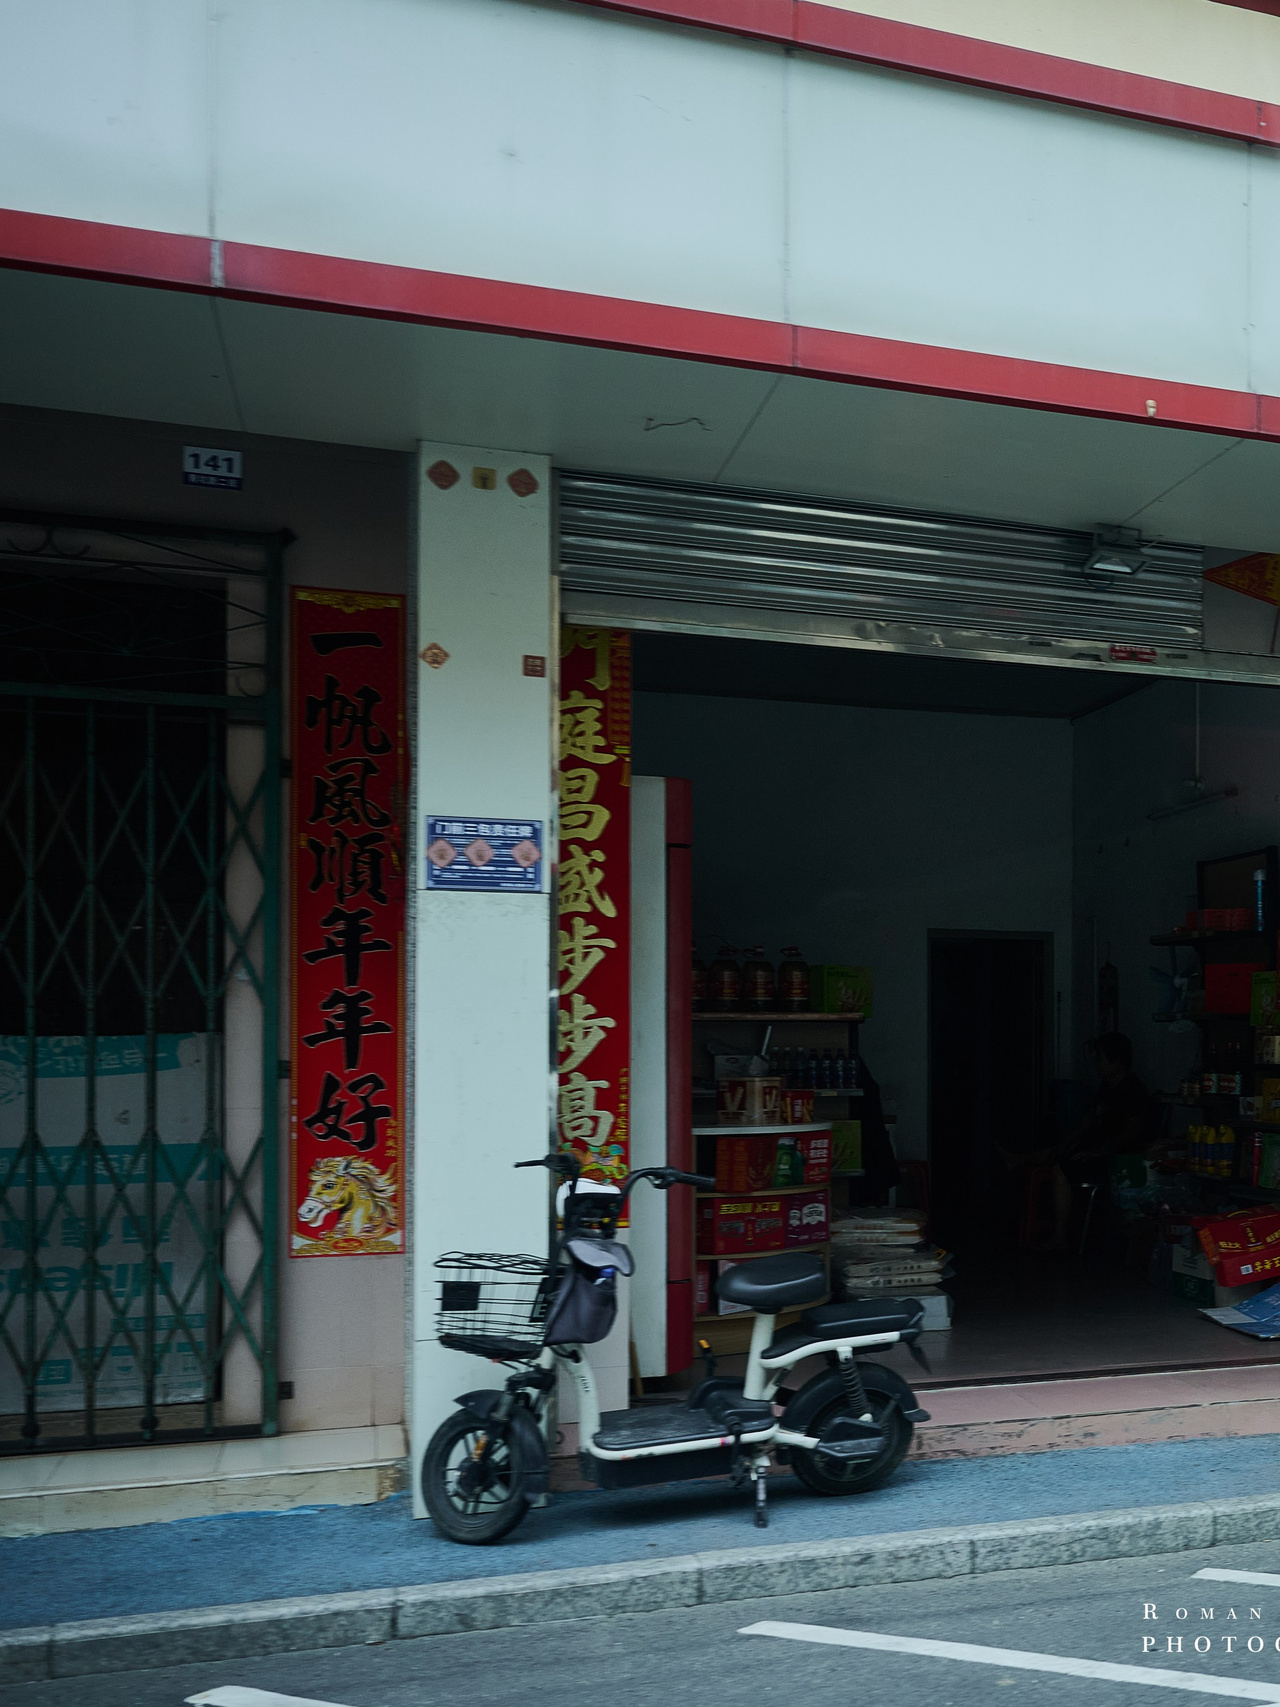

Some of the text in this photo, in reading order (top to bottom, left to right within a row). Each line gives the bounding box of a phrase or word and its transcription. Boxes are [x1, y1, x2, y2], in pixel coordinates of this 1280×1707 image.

[188, 453, 234, 473] 141
[435, 821, 533, 837] 门前三包责任牌
[302, 631, 393, 1150] 一帆風順年年好
